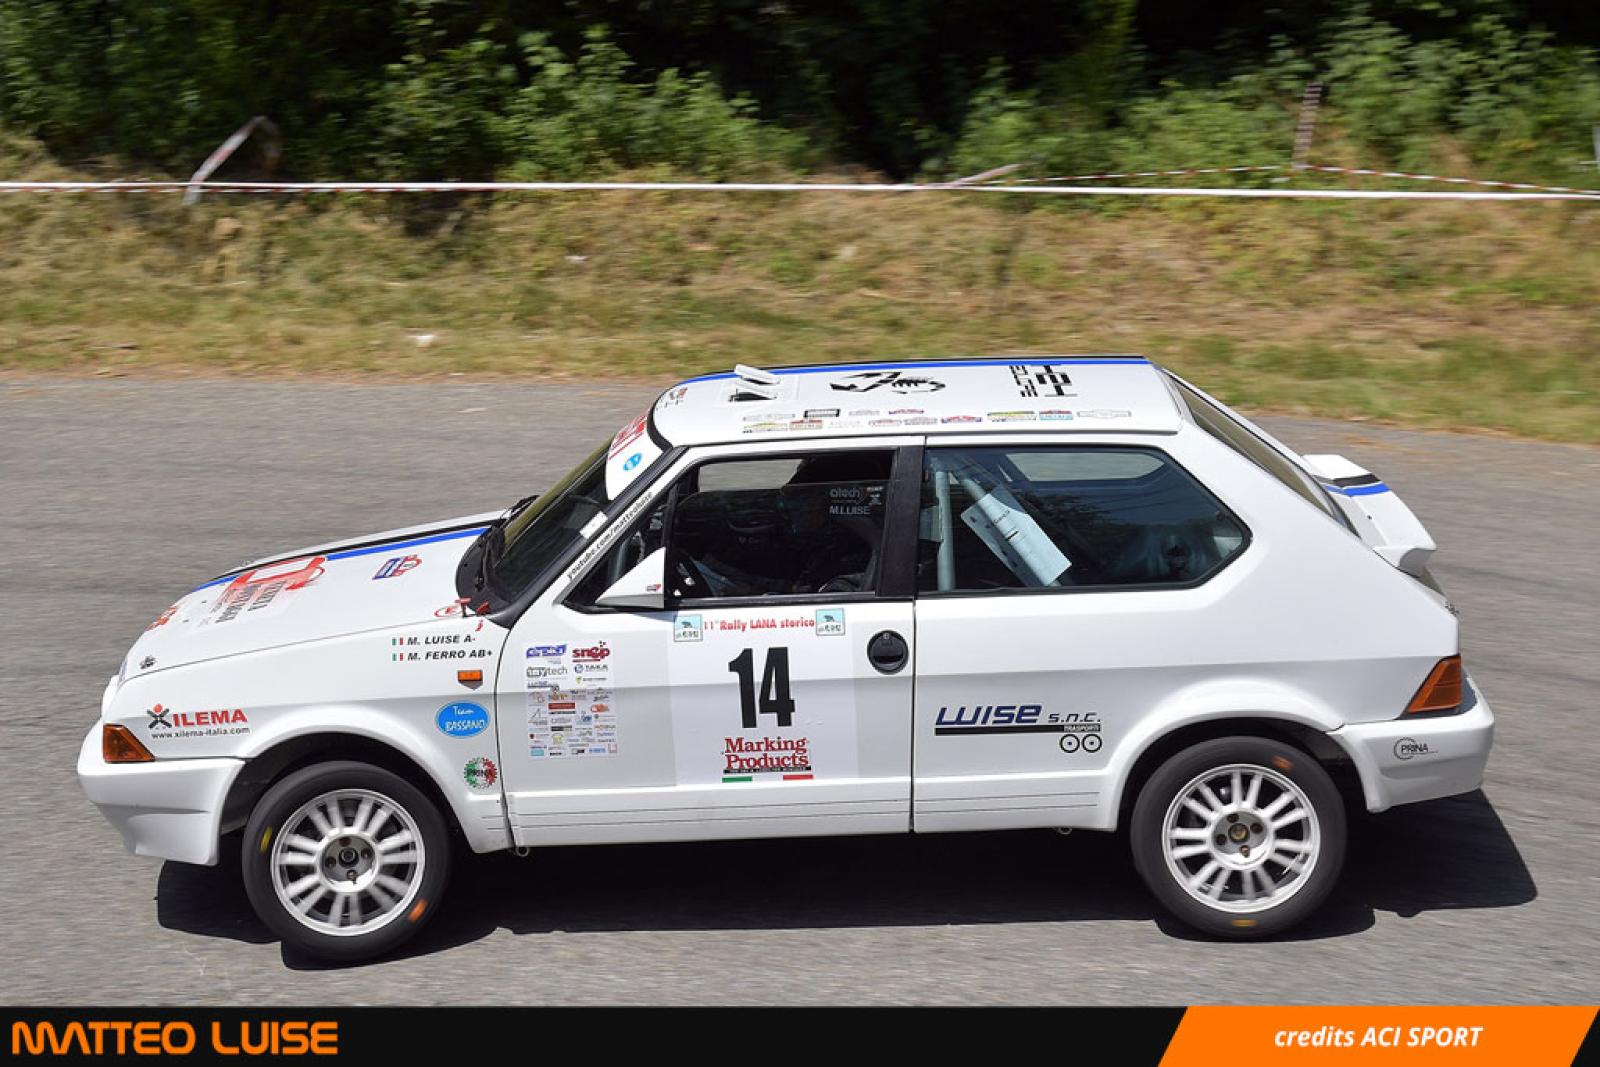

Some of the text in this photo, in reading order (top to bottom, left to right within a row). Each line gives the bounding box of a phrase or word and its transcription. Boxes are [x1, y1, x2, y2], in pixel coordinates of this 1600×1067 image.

[720, 619, 747, 632] Rally
[750, 617, 777, 629] LANA
[780, 616, 815, 628] storico
[407, 637, 421, 646] M.
[424, 635, 460, 645] LUISE
[407, 649, 493, 661] M. FERRO AB+
[728, 647, 795, 728] 14
[725, 736, 807, 755] Marking
[725, 752, 809, 769] Products
